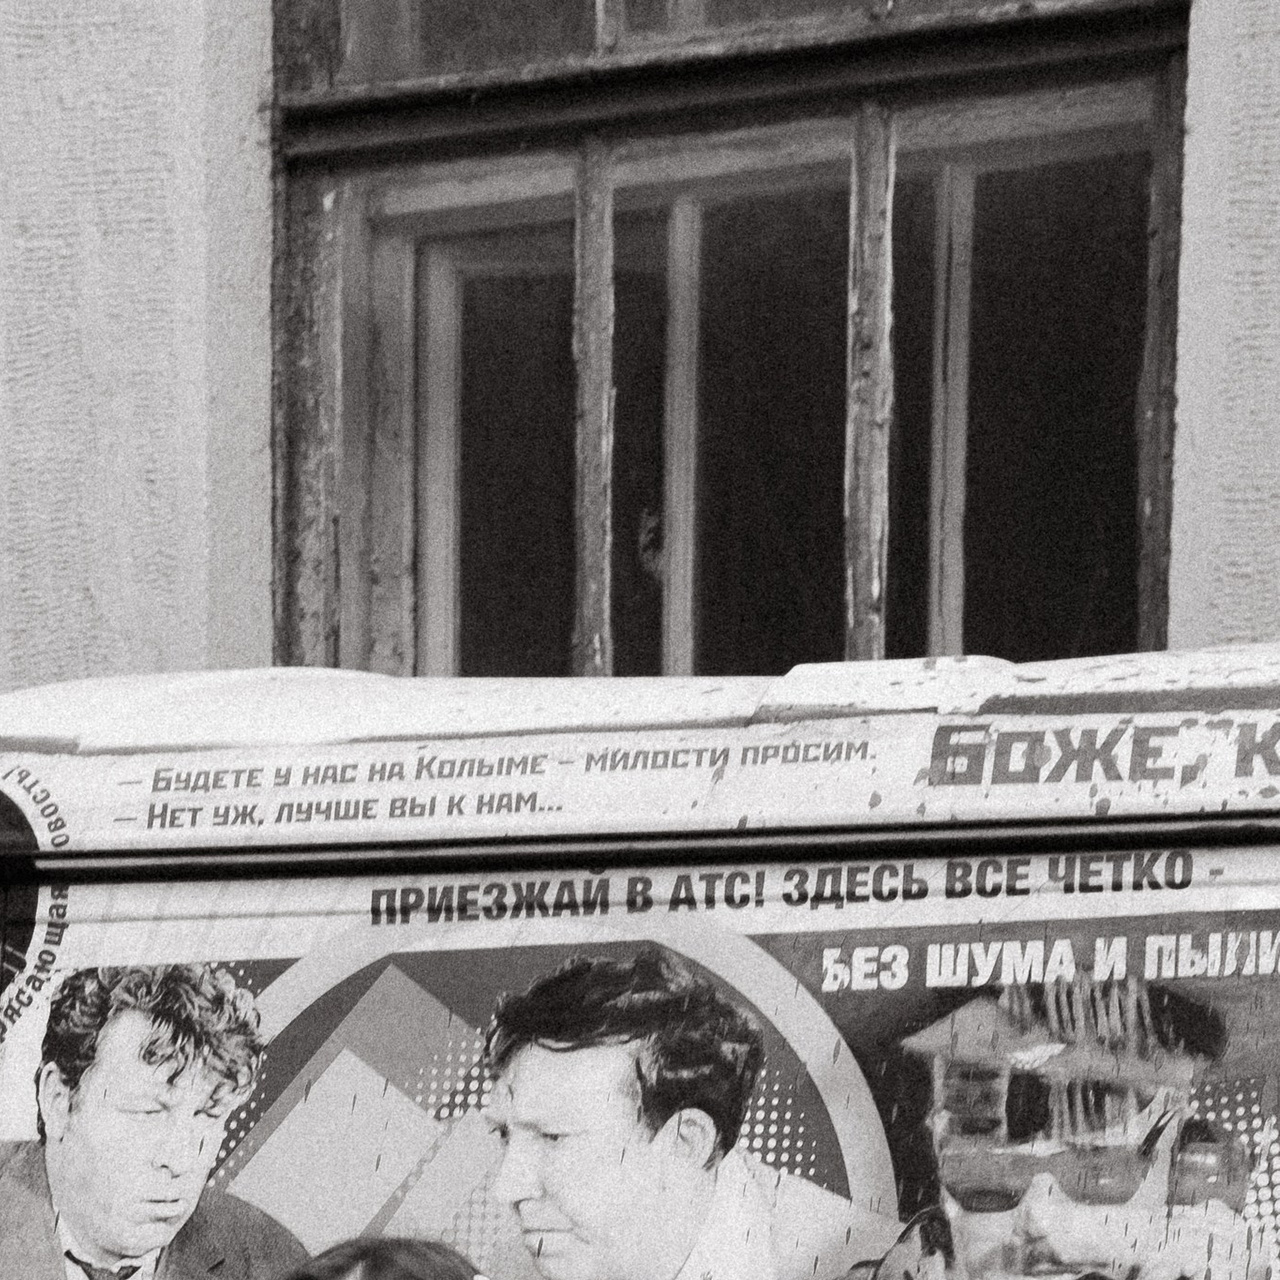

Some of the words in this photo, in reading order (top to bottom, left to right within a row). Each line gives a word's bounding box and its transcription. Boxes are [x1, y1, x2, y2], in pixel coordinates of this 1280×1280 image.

[2, 765, 70, 848] овость!
[371, 870, 610, 926] ПРИЕЗЖАЙ
[626, 876, 653, 913] В
[668, 869, 765, 912] АТС!
[782, 862, 929, 910] ЗДЕСЬ
[946, 856, 1032, 899] ВСЕ
[1048, 850, 1194, 894] ЧЕТКО
[925, 938, 1076, 989] ШУМА
[1093, 936, 1127, 982] И
